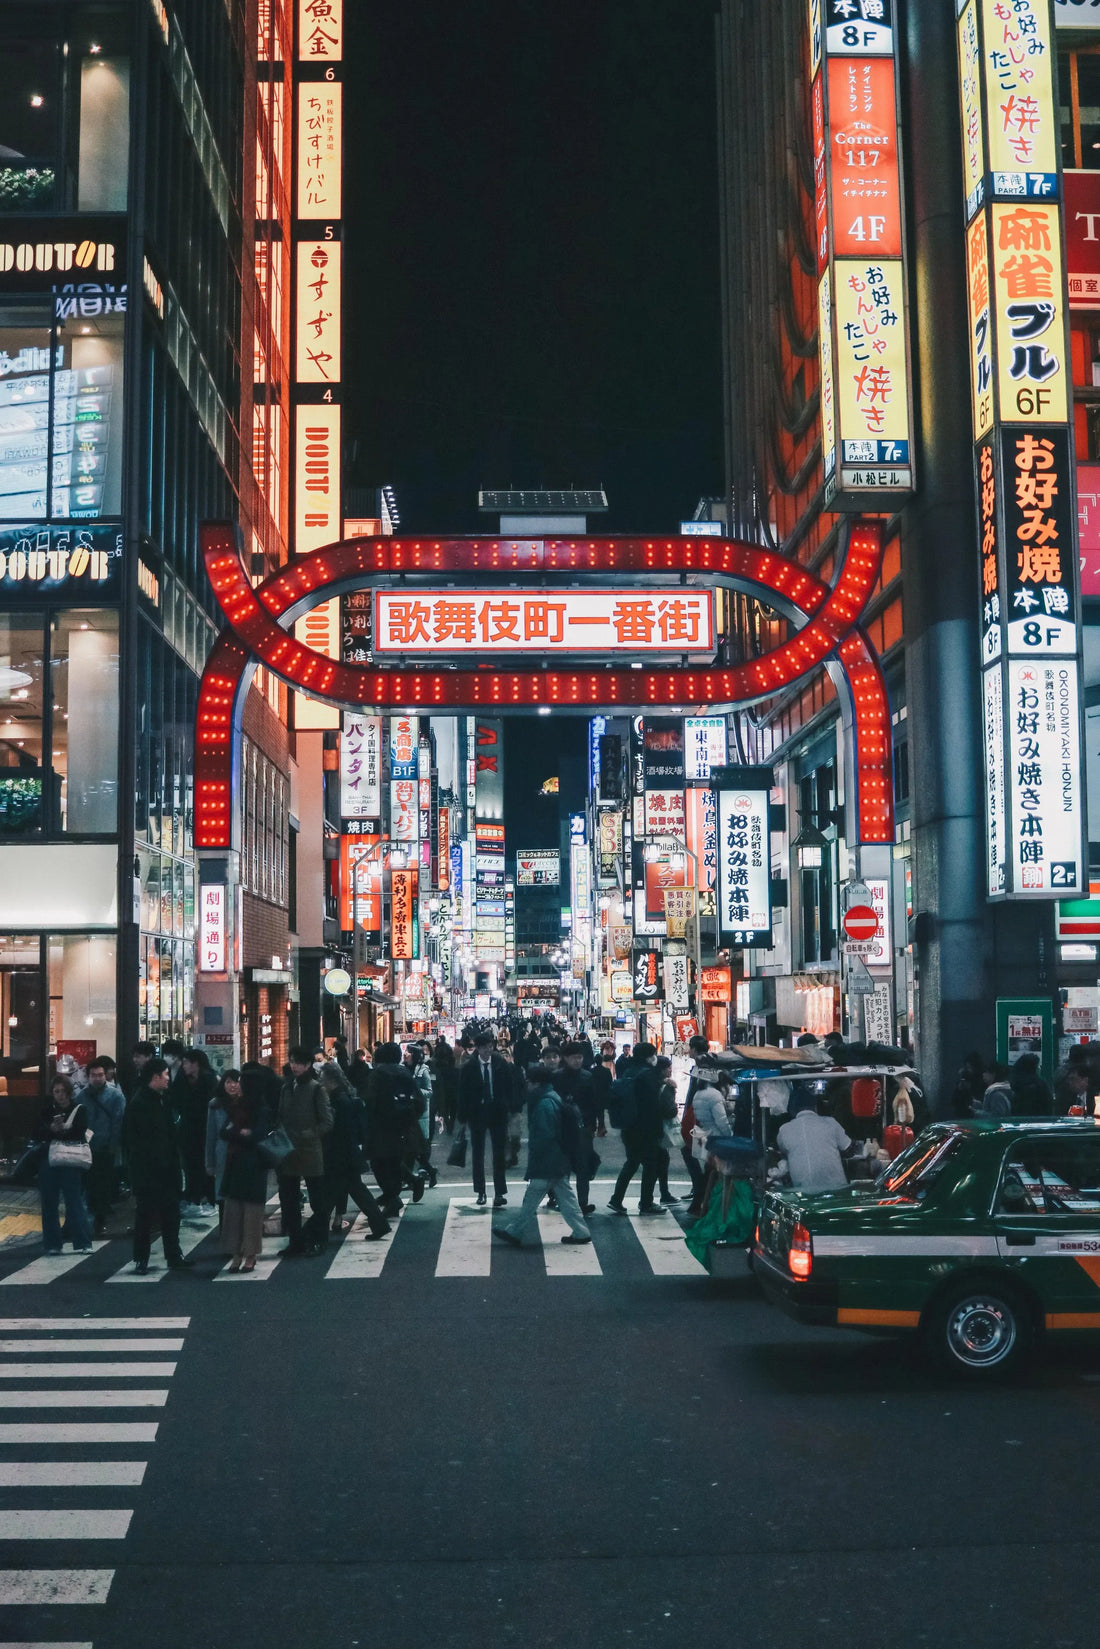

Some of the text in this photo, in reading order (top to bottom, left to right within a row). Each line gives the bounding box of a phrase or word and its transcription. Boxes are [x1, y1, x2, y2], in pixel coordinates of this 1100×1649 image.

[305, 0, 338, 56] 魚金
[842, 25, 877, 47] 8F
[994, 3, 1034, 83] もんじゃ
[325, 68, 335, 80] 6
[990, 51, 1017, 90] たこ
[849, 65, 858, 113] レストラン
[862, 65, 873, 113] ダイニング
[835, 133, 889, 145] Corner
[852, 121, 871, 131] The
[1000, 94, 1041, 164] 焼き
[306, 97, 328, 205] ちびすけバル
[845, 150, 880, 167] 117
[842, 178, 888, 186] ザ・コーナー
[842, 189, 888, 198] イチイチナナ
[998, 186, 1025, 194] PART2
[1029, 174, 1052, 195] 7F
[324, 227, 334, 240] 5
[848, 215, 886, 243] 4F
[0, 240, 114, 271] DOUTOR
[866, 266, 898, 326] お好み
[1069, 279, 1100, 293] 個室
[306, 272, 332, 382] すずや
[848, 275, 887, 354] もんじゃ
[844, 322, 870, 361] たこ
[322, 390, 333, 402] 4
[853, 365, 893, 433] 焼き
[1016, 387, 1052, 415] 6F
[979, 396, 990, 429] 6F
[849, 452, 875, 461] PART2
[881, 441, 902, 461] 7F
[305, 427, 329, 528] DOUTOR
[852, 472, 900, 486] 小松ビル
[980, 446, 997, 596] お好み焼
[1014, 434, 1063, 583] お好み焼
[1013, 586, 1069, 615] 本陣
[388, 600, 700, 643] 歌舞伎町一番街
[1022, 621, 1061, 647] 8F
[987, 631, 998, 655] 8F
[1045, 670, 1056, 732] 歌舞伎町名物
[696, 729, 708, 778] 東南荘
[1058, 669, 1073, 812] OKONOMIYAKI HONJIN
[345, 723, 365, 791] バンタイ
[393, 767, 416, 776] B1F
[1016, 686, 1044, 865] お好み焼き本陣
[353, 806, 368, 814] 3F
[649, 794, 685, 811] 焼肉
[347, 821, 374, 834] 焼肉
[727, 814, 750, 922] お好み焼本陣
[1052, 865, 1075, 884] 2F
[206, 892, 220, 964] 劇場通り
[735, 931, 754, 943] 2F
